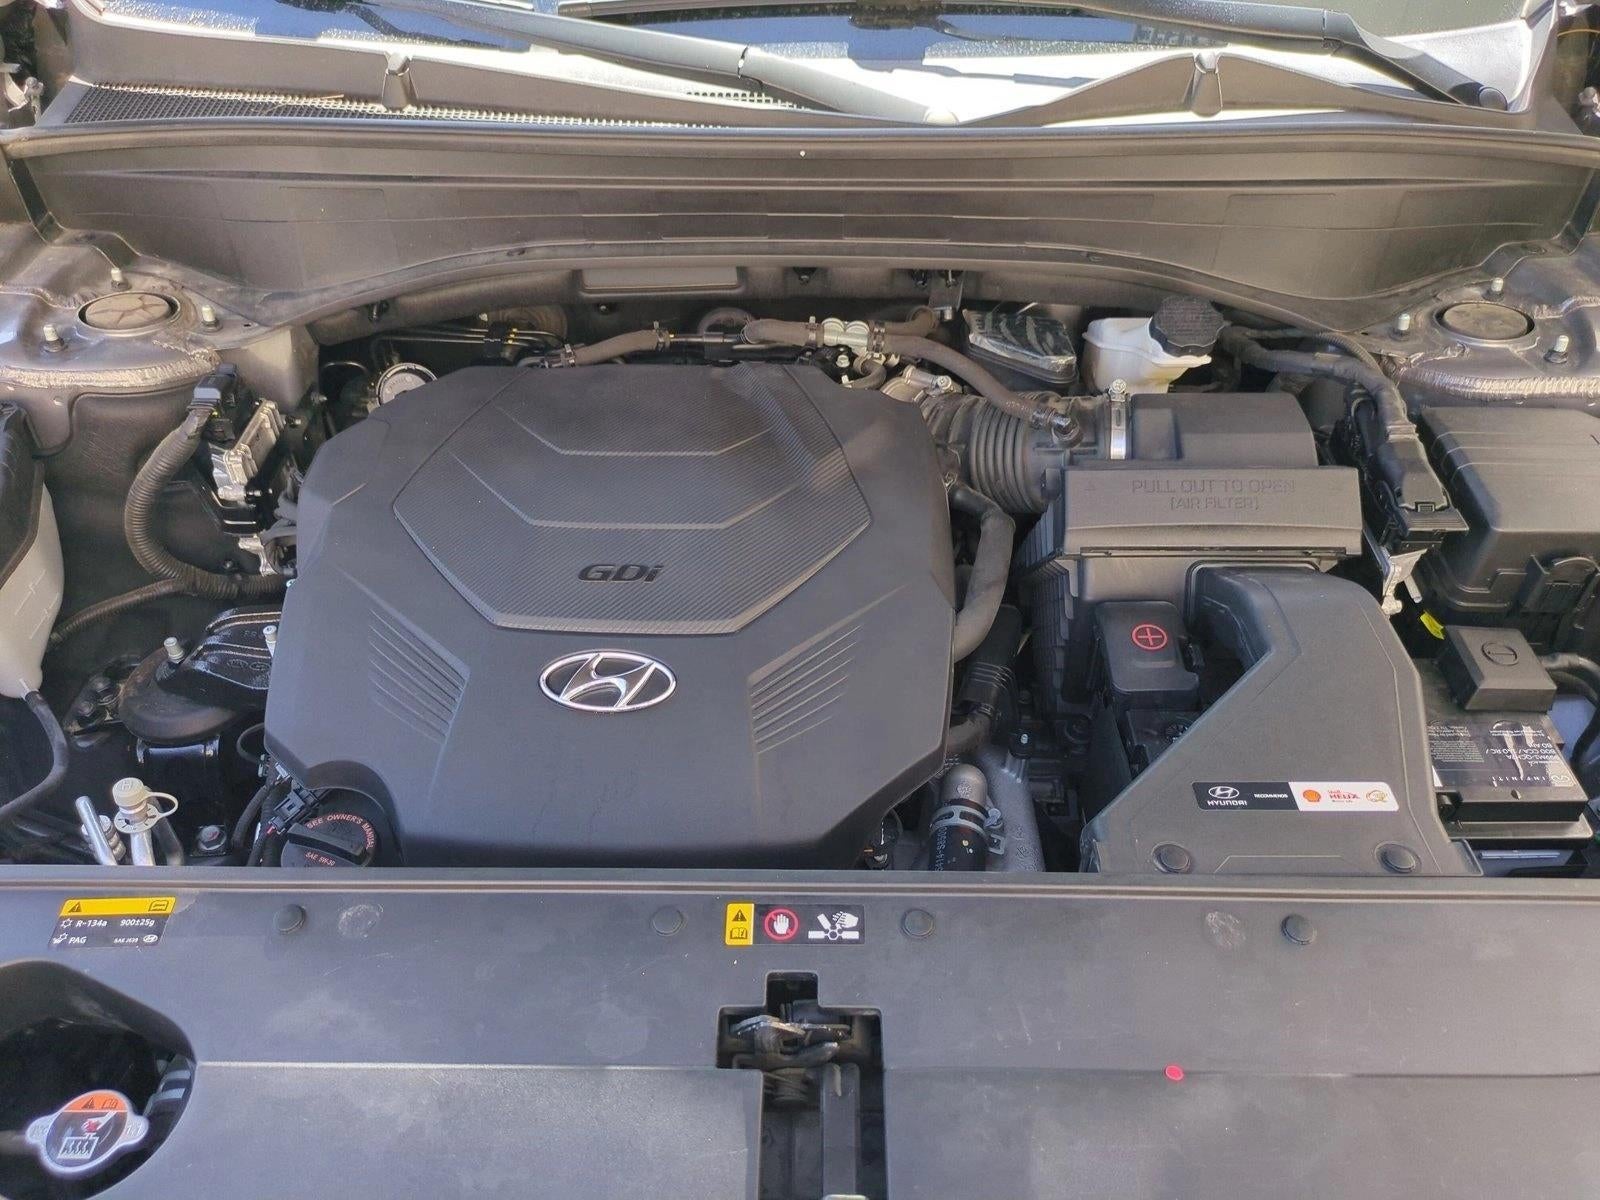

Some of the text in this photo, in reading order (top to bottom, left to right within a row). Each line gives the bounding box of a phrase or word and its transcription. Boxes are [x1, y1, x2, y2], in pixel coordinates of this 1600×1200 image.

[1131, 479, 1296, 493] PULL OUT TO OPEN
[577, 564, 664, 581] GDi
[306, 817, 323, 829] SEE
[326, 813, 363, 825] OWNER'S
[305, 851, 318, 860] SAE
[75, 918, 155, 928] R-134a 900±25g
[68, 936, 87, 944] PAG
